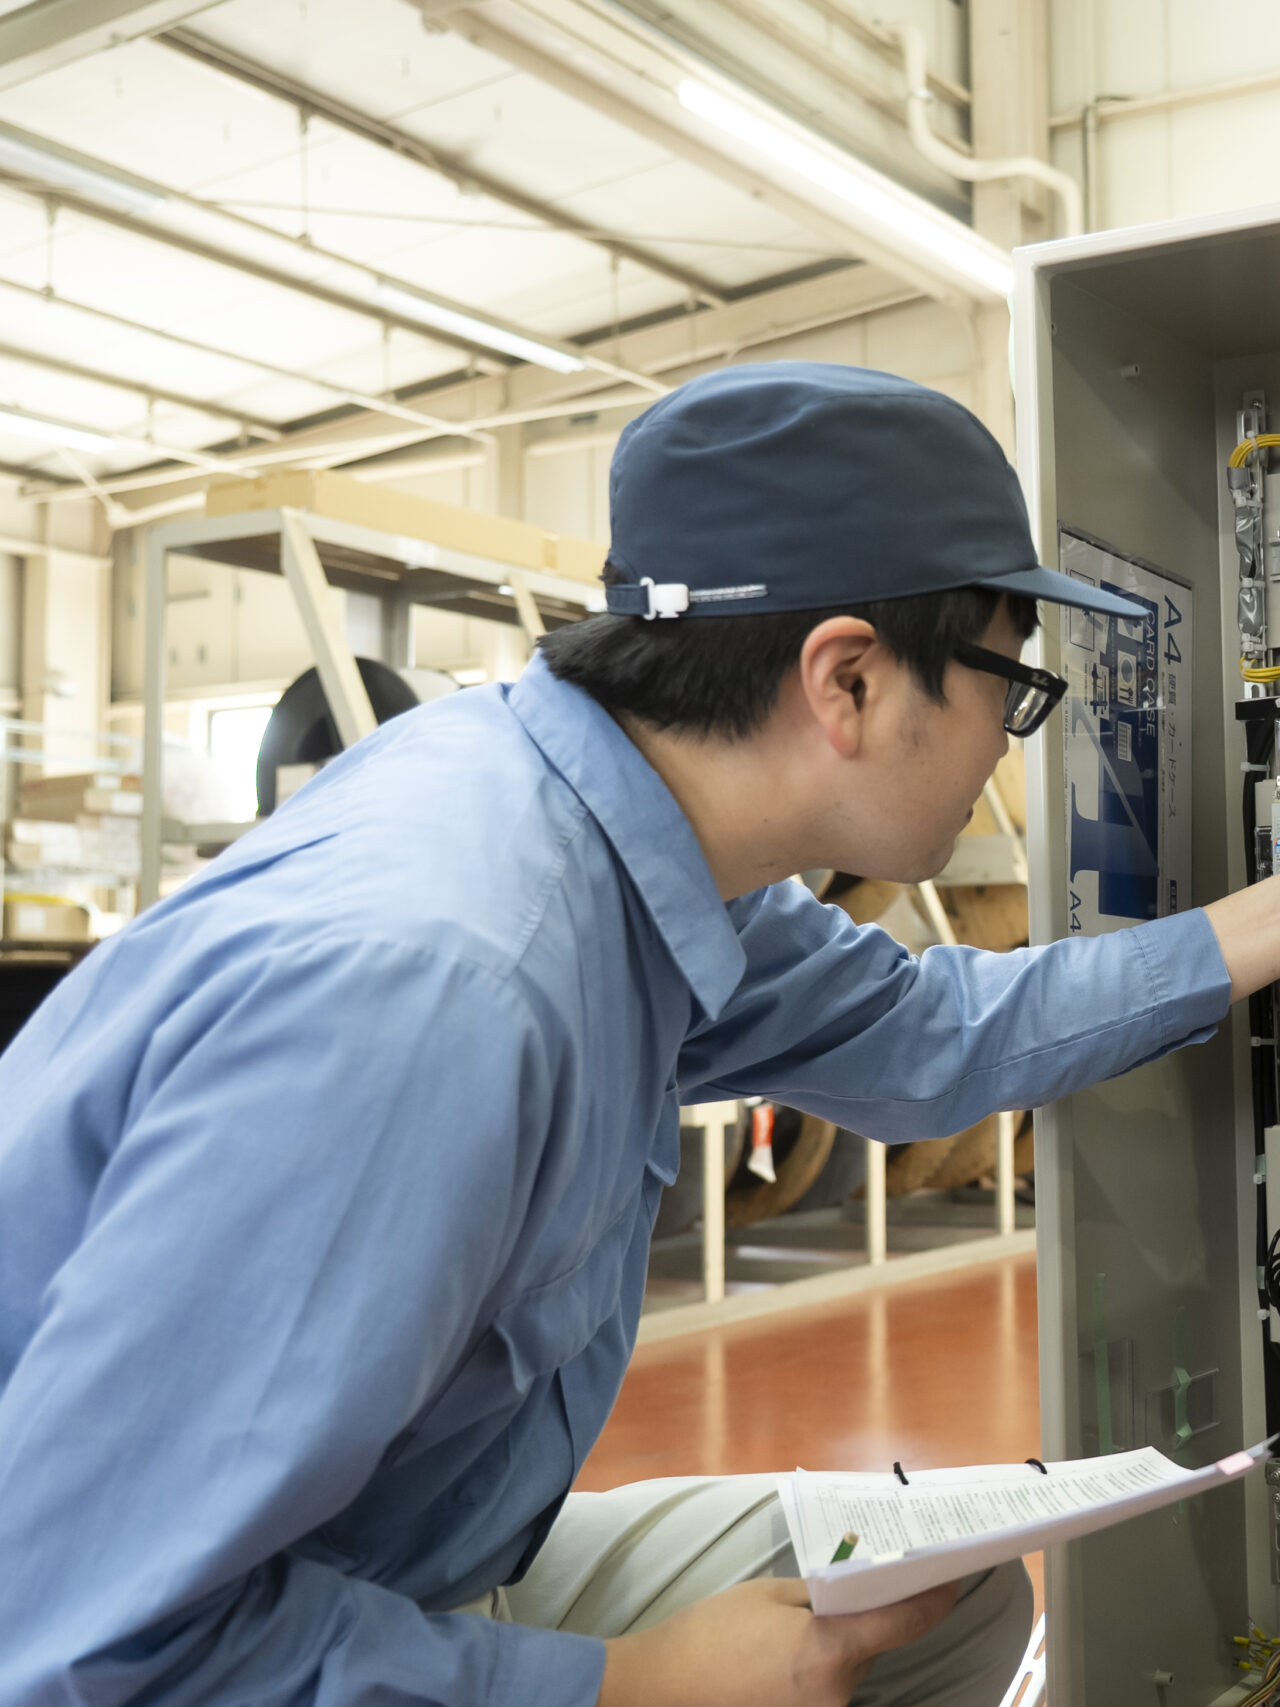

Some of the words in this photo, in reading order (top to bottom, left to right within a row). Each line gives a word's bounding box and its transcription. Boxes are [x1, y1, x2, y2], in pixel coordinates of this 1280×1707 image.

[1146, 609, 1155, 671] CARD
[1164, 594, 1182, 665] A4
[1146, 678, 1156, 737] CASE
[1069, 890, 1082, 933] A4
